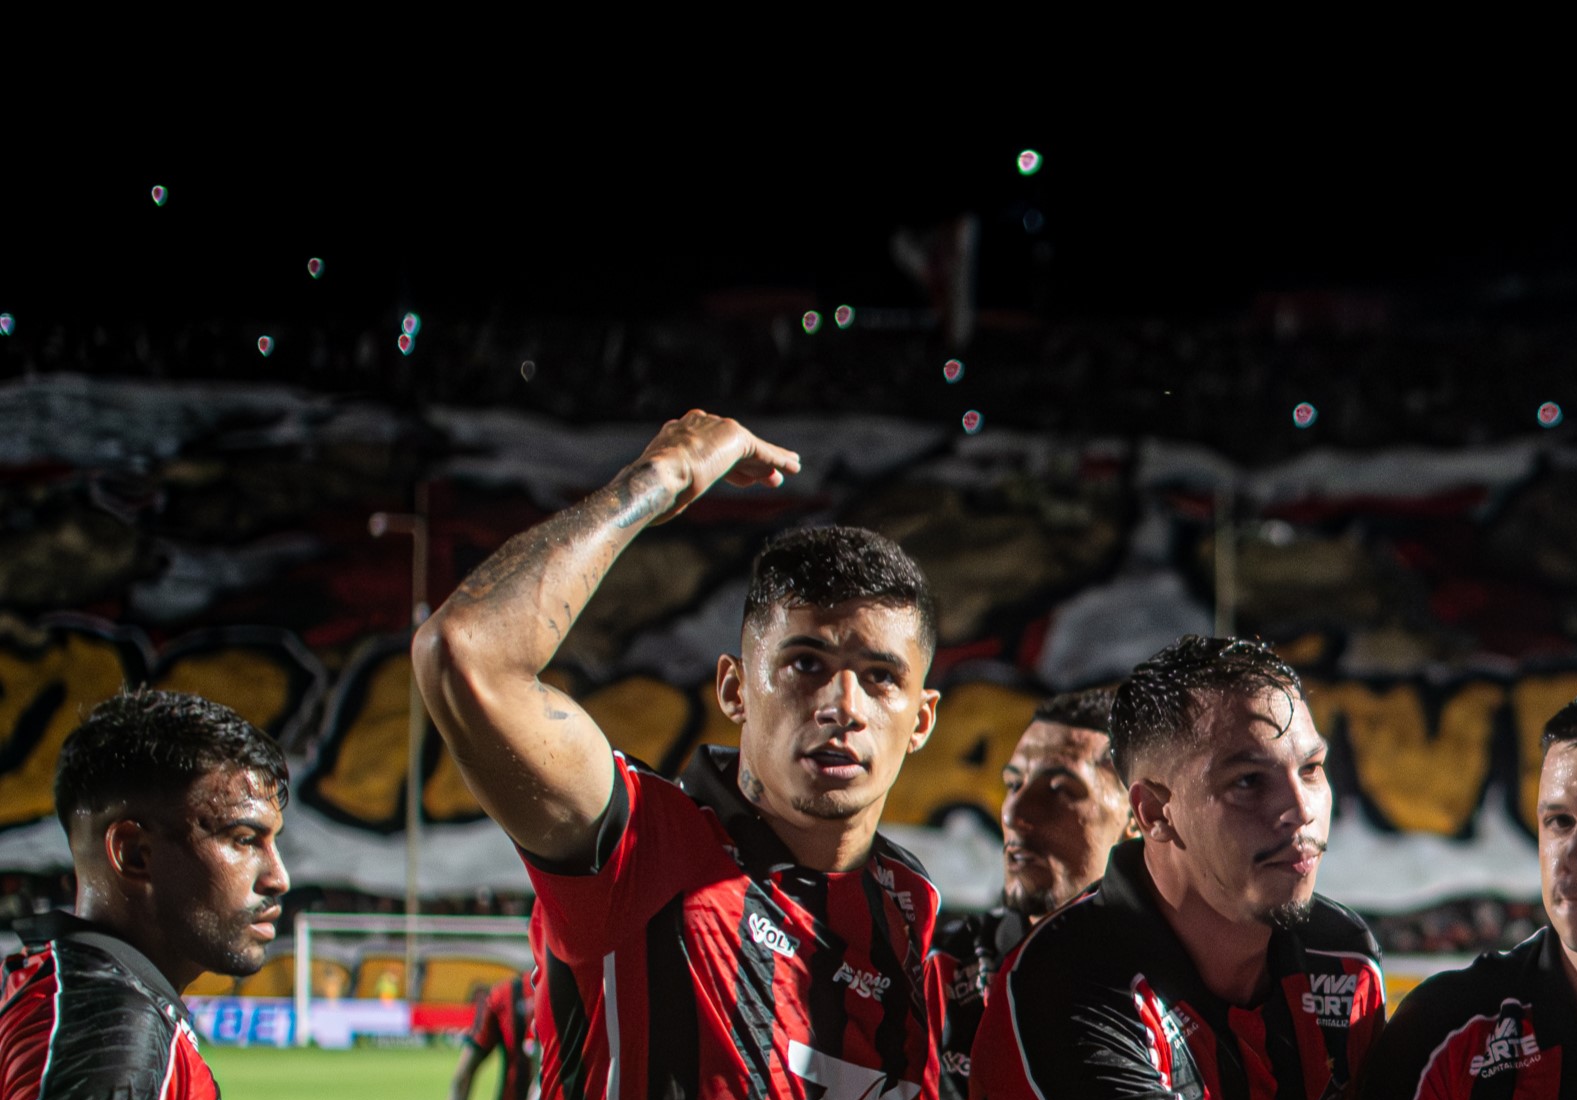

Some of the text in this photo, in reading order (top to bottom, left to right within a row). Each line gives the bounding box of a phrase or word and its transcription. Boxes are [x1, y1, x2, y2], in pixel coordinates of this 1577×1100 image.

[749, 913, 800, 958] VOLT
[1309, 973, 1357, 994] VIVA
[1302, 991, 1354, 1017] SORT
